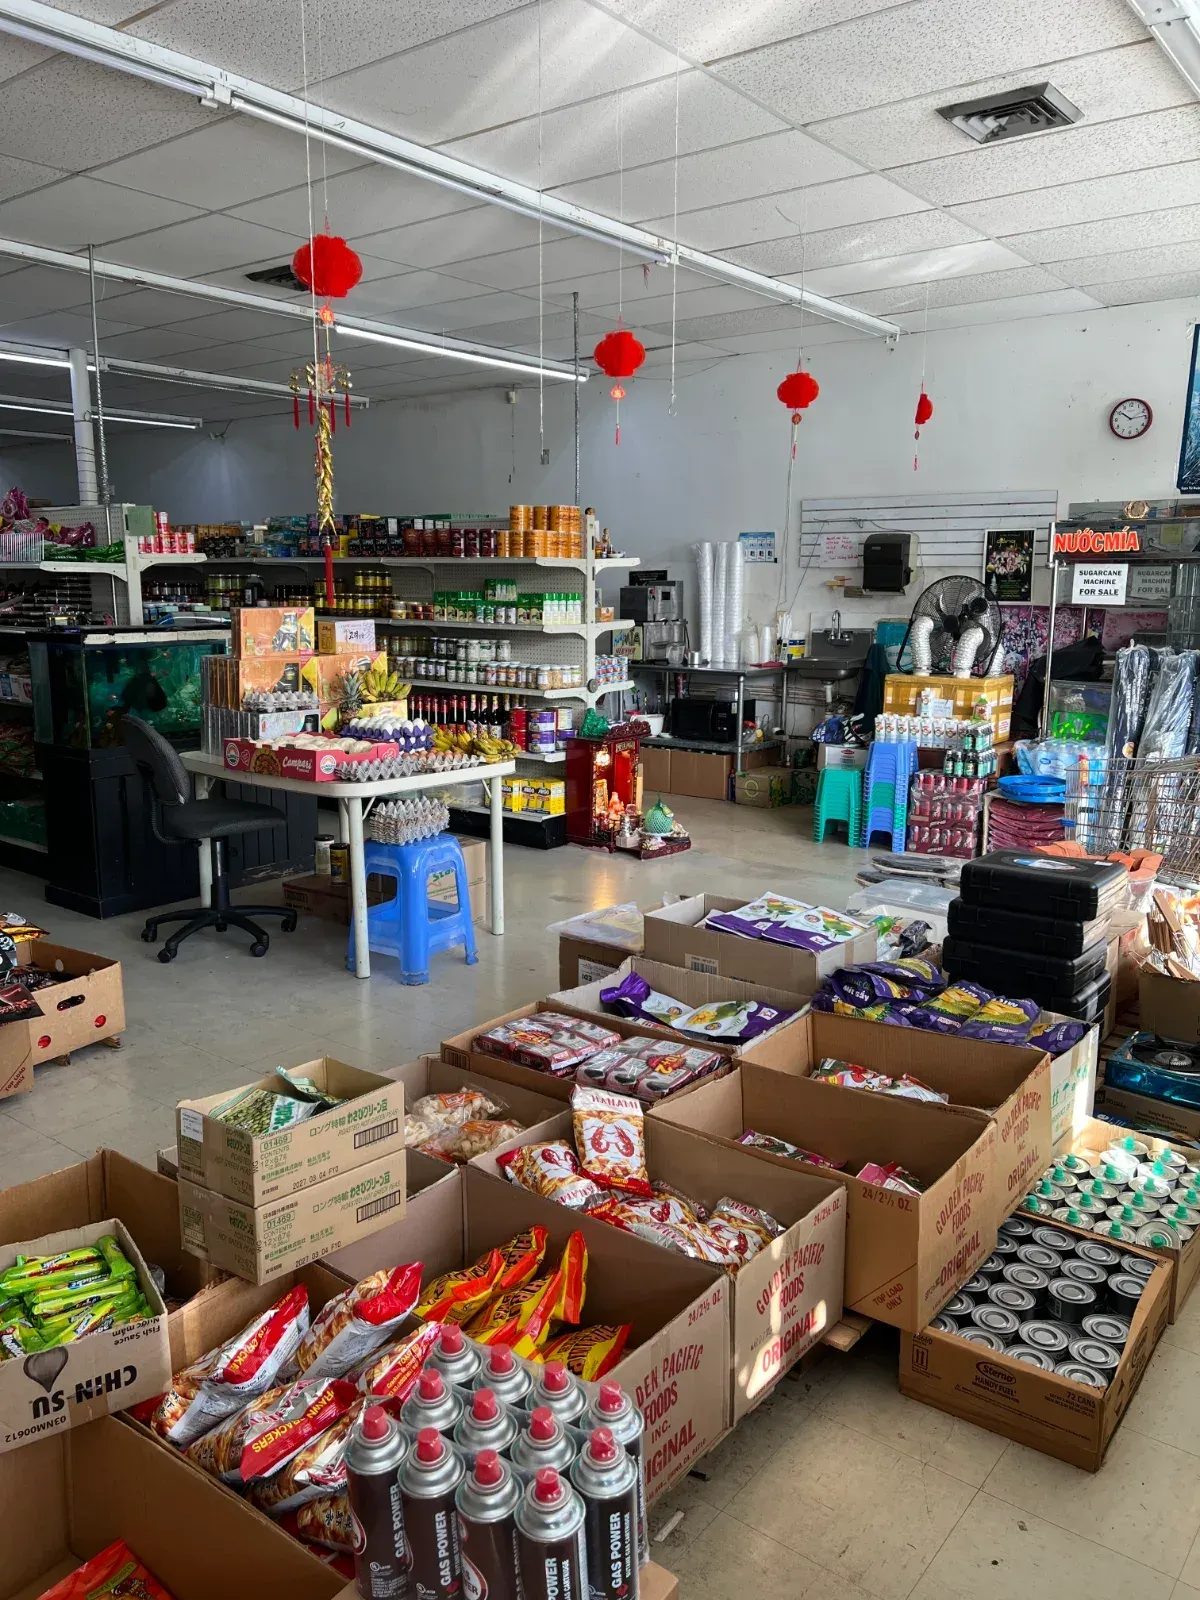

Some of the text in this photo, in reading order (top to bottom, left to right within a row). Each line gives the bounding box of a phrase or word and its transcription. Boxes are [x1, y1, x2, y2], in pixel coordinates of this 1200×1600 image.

[282, 756, 312, 771] Campari
[5, 1067, 26, 1092] TOP LOAD
[14, 1076, 26, 1088] ONLY
[592, 1094, 638, 1110] HANAMI
[1022, 1091, 1042, 1114] PACIFIC
[260, 1145, 290, 1160] CONTENTS
[264, 1136, 288, 1150] 01469
[1007, 1146, 1040, 1192] ORIGINAL
[898, 1197, 913, 1212] OZ.
[936, 1172, 985, 1236] GOLDEN PACIFIC
[951, 1198, 972, 1234] FOODS
[263, 1222, 293, 1240] CONTENTS
[266, 1214, 292, 1230] 01469
[295, 1255, 309, 1268] 2027
[939, 1230, 981, 1288] ORIGINAL
[756, 1242, 825, 1316] GOLDEN PACIFIC
[712, 1288, 723, 1306] OZ.
[778, 1272, 804, 1313] FOODS
[872, 1282, 904, 1306] TOP LOAD
[886, 1298, 903, 1311] ONLY
[784, 1304, 799, 1325] INC.
[114, 1324, 161, 1346] Fish Sauce
[762, 1307, 818, 1373] ORIGINAL
[635, 1366, 660, 1408] DEN
[662, 1344, 704, 1383] PACIFIC
[975, 1375, 1000, 1390] HANDY
[999, 1382, 1016, 1396] FUEL
[982, 1365, 1014, 1383] Sterno
[644, 1380, 678, 1432] FOODS
[1066, 1391, 1076, 1401] 72
[1077, 1394, 1096, 1409] CANS
[4, 1414, 67, 1444] 03NM00612
[252, 1418, 301, 1454] RACKERS
[652, 1419, 671, 1444] INC.
[645, 1418, 696, 1488] IGINAL
[390, 1482, 405, 1558] GAS POWER
[434, 1510, 452, 1586] GAS POWER
[610, 1512, 623, 1589] GAS POWER
[544, 1558, 560, 1600] POWER
[562, 1560, 570, 1592] CARTRIDGE
